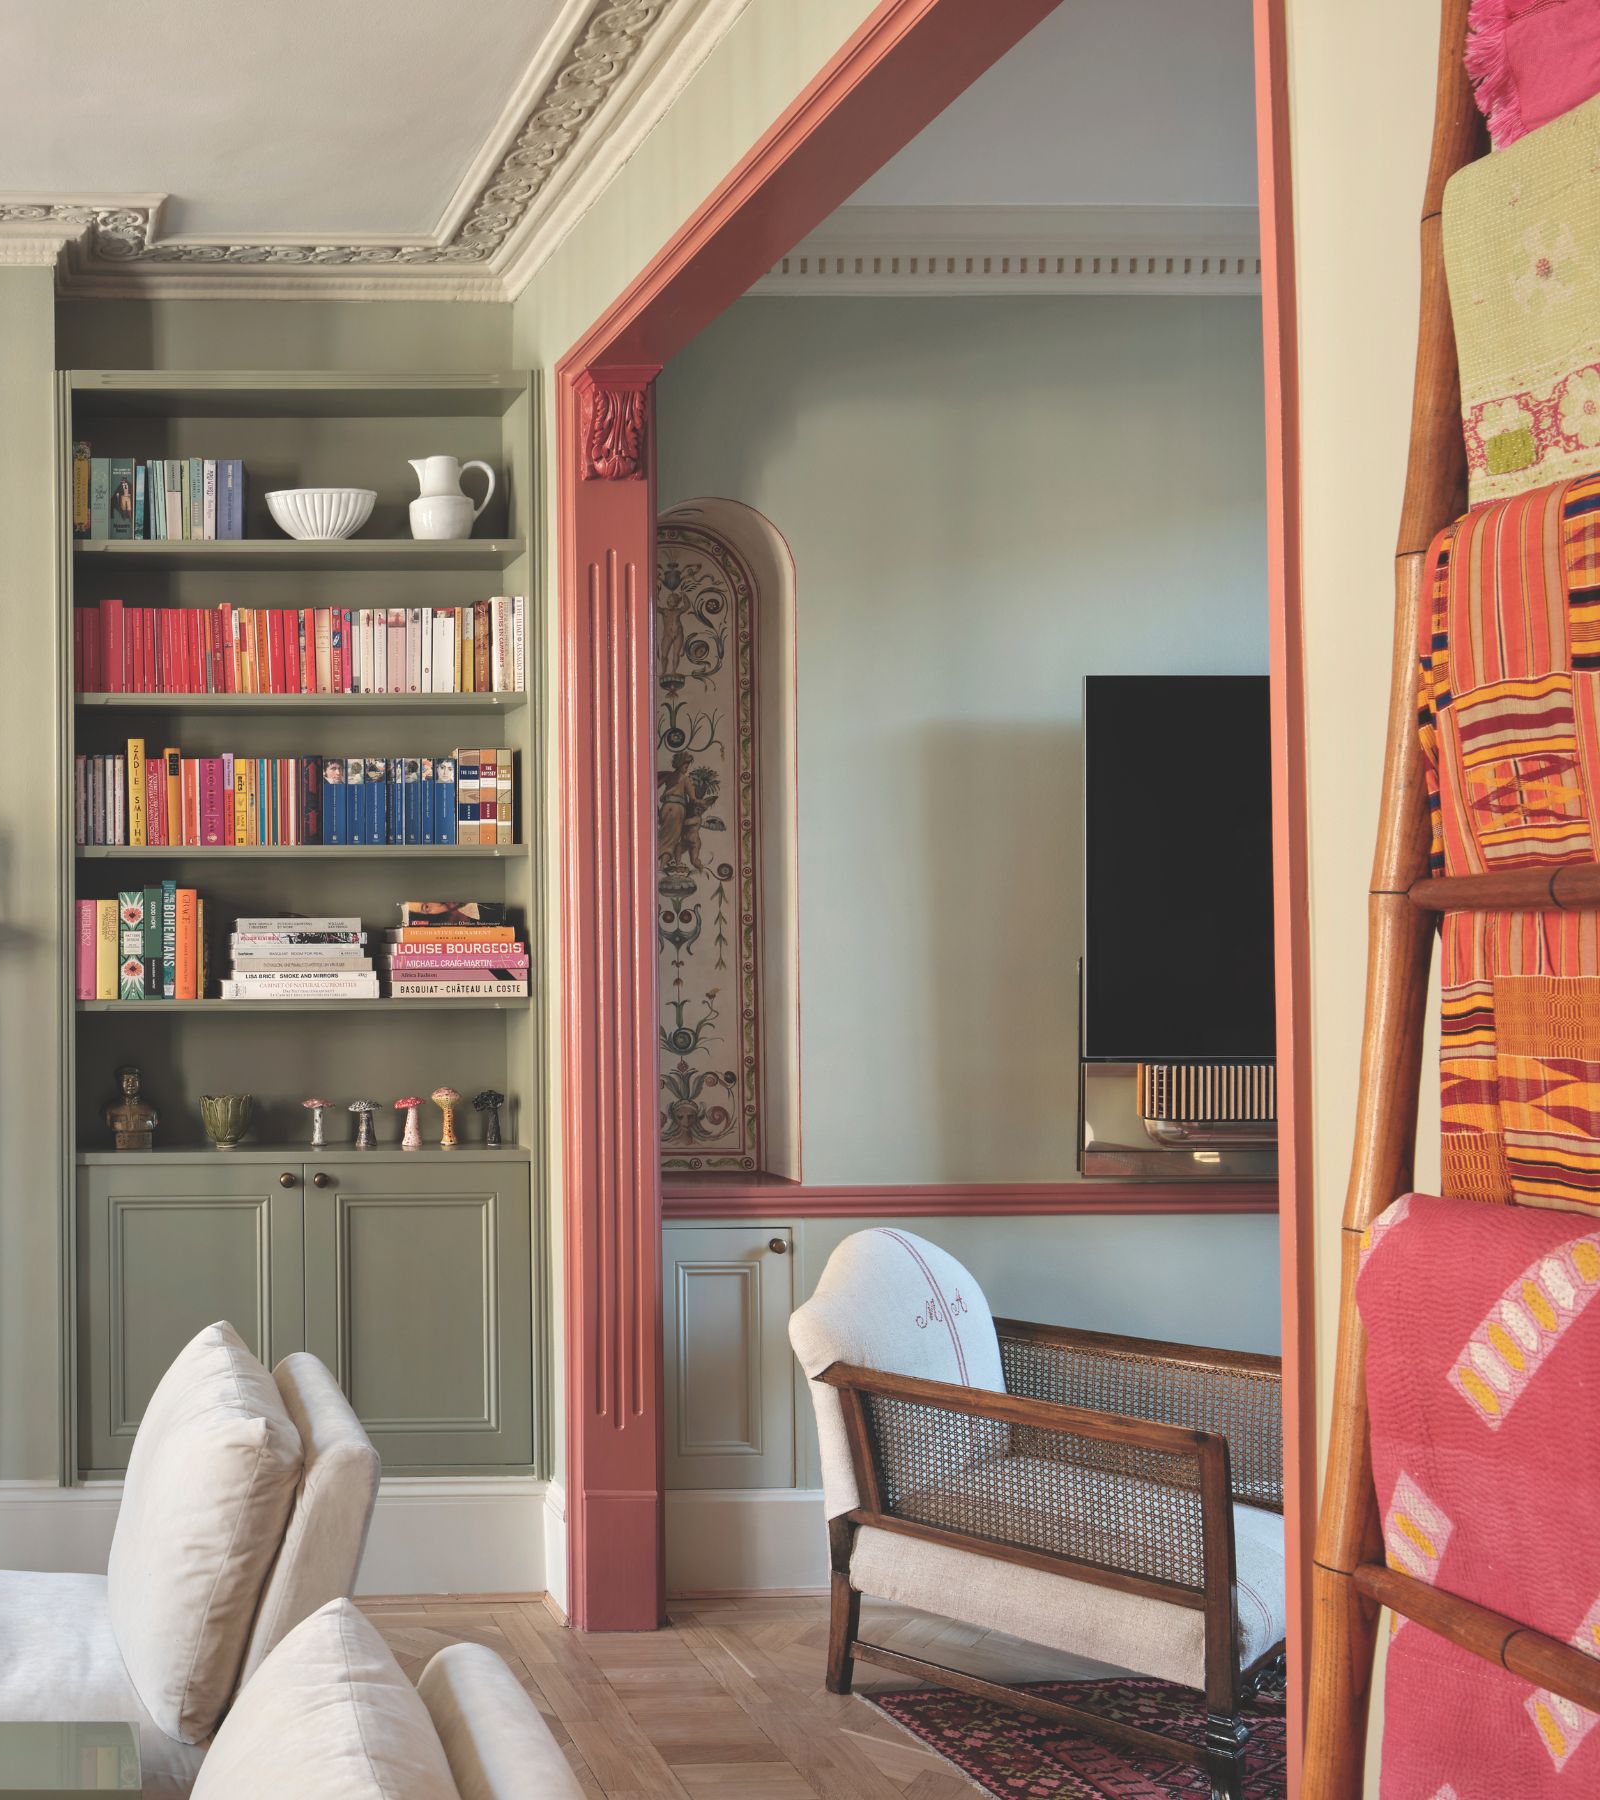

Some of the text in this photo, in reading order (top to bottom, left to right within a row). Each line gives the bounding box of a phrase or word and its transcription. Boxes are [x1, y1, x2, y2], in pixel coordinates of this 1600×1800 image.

[182, 894, 191, 924] GRACE
[164, 905, 175, 966] BOHEMIANS
[398, 943, 522, 954] LOUISE BOURGEOIS
[446, 984, 480, 993] CHÂTEAU
